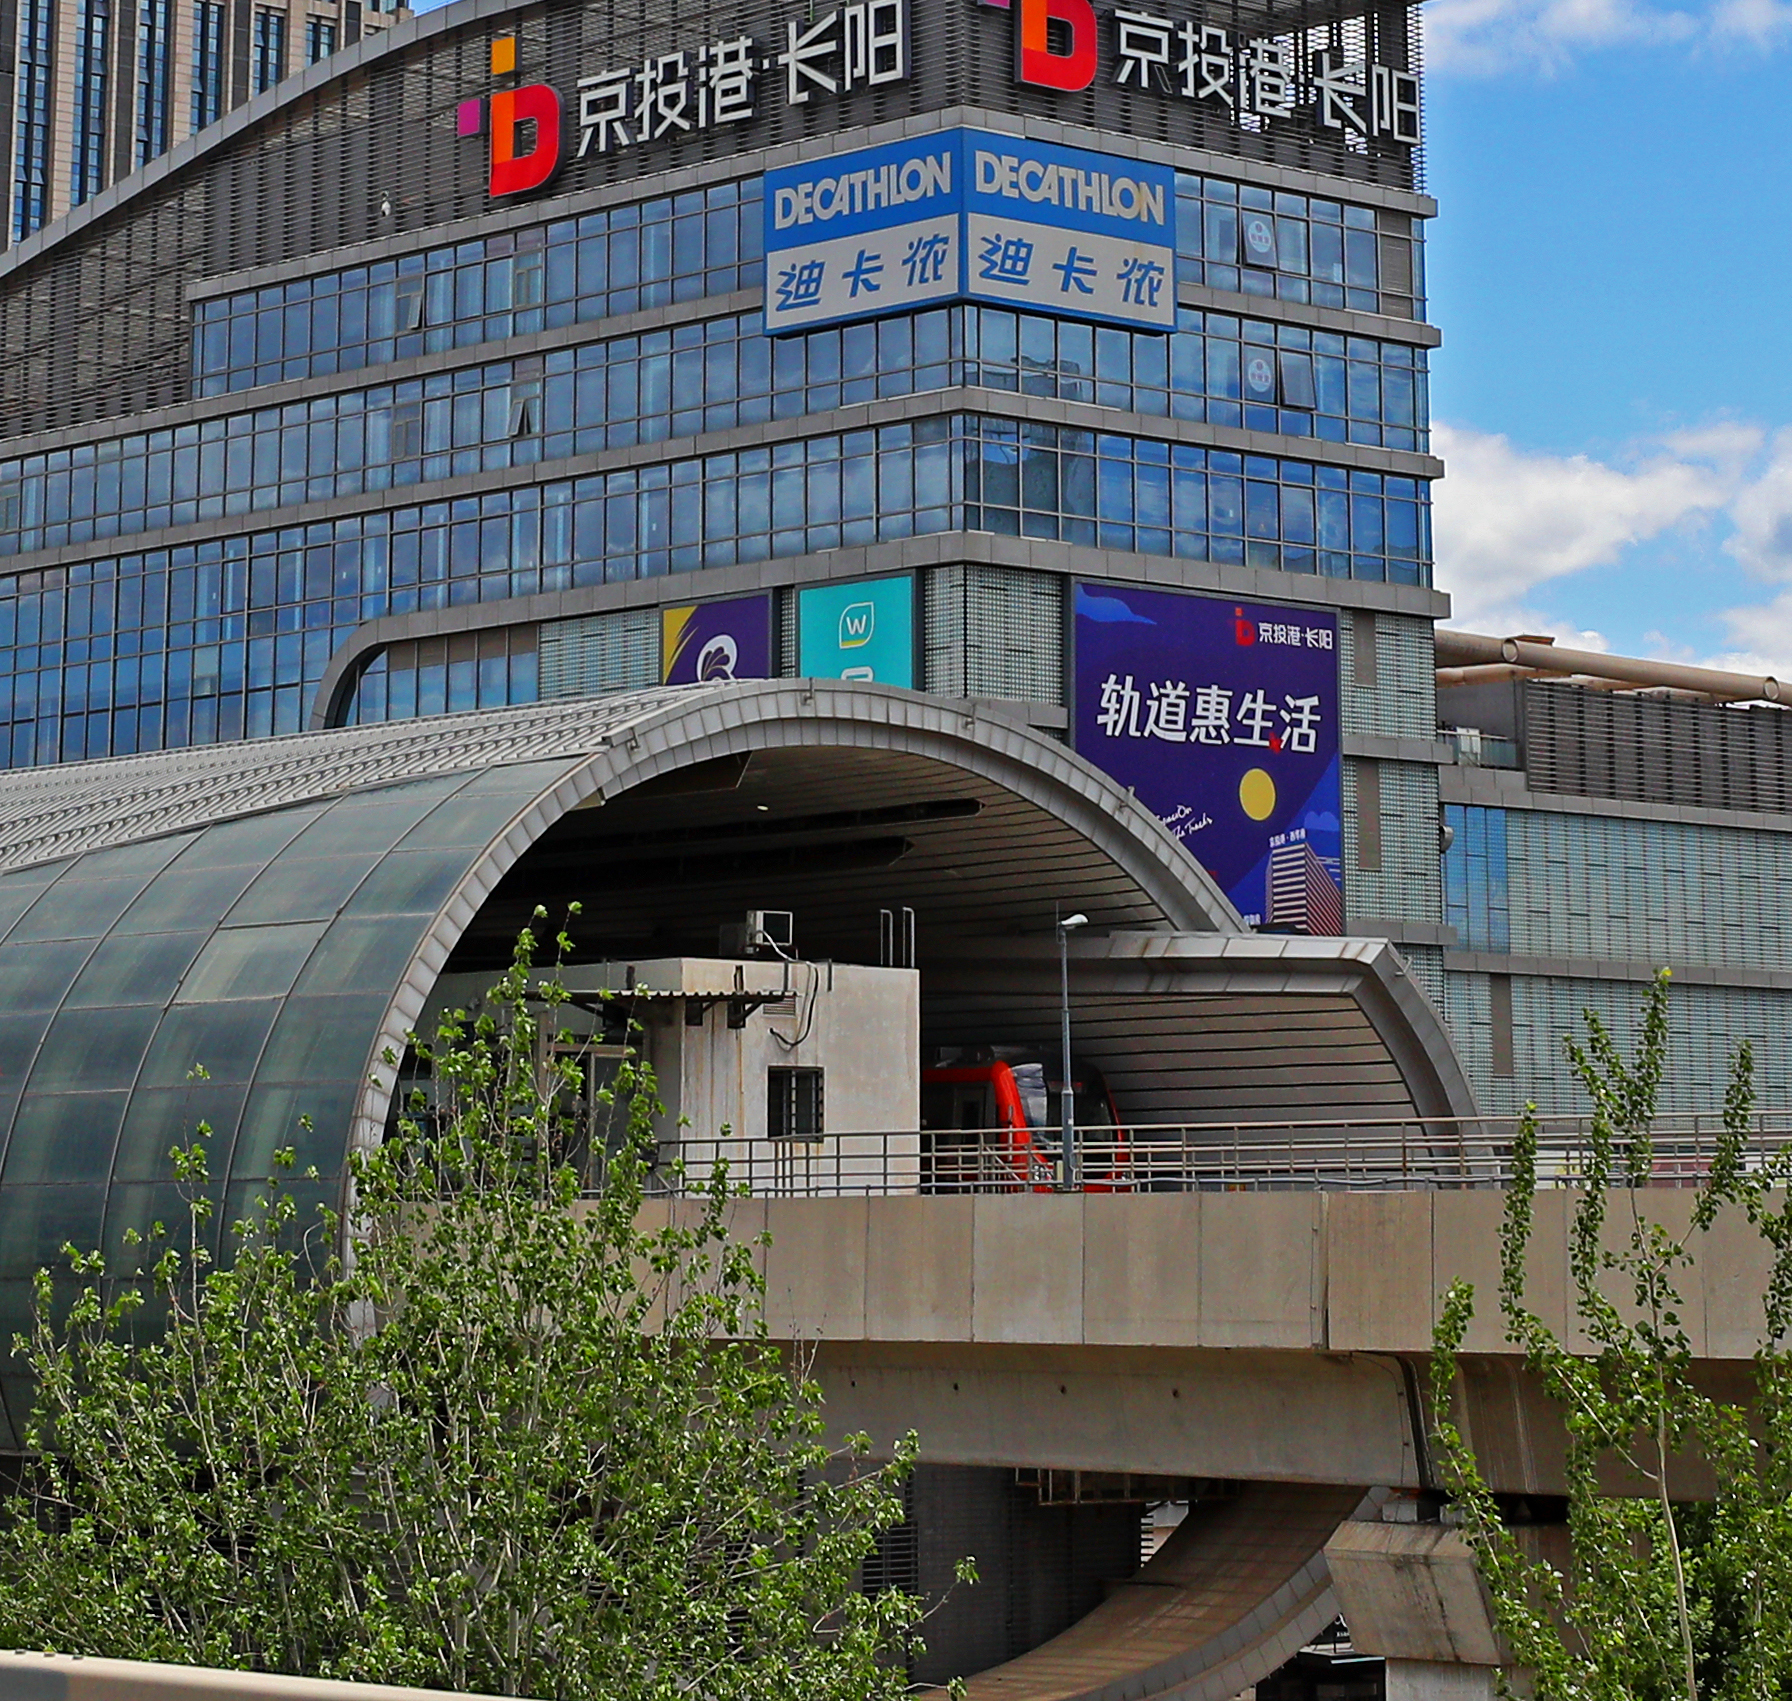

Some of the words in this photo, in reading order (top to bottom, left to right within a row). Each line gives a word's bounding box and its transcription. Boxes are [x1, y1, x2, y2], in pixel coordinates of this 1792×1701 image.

[774, 150, 952, 231] DECATHLON
[974, 149, 1165, 227] DECATHLON
[774, 232, 950, 313] 迪卡侬
[977, 232, 1166, 308] 迪卡侬
[1096, 673, 1322, 754] 轨道惠生活
